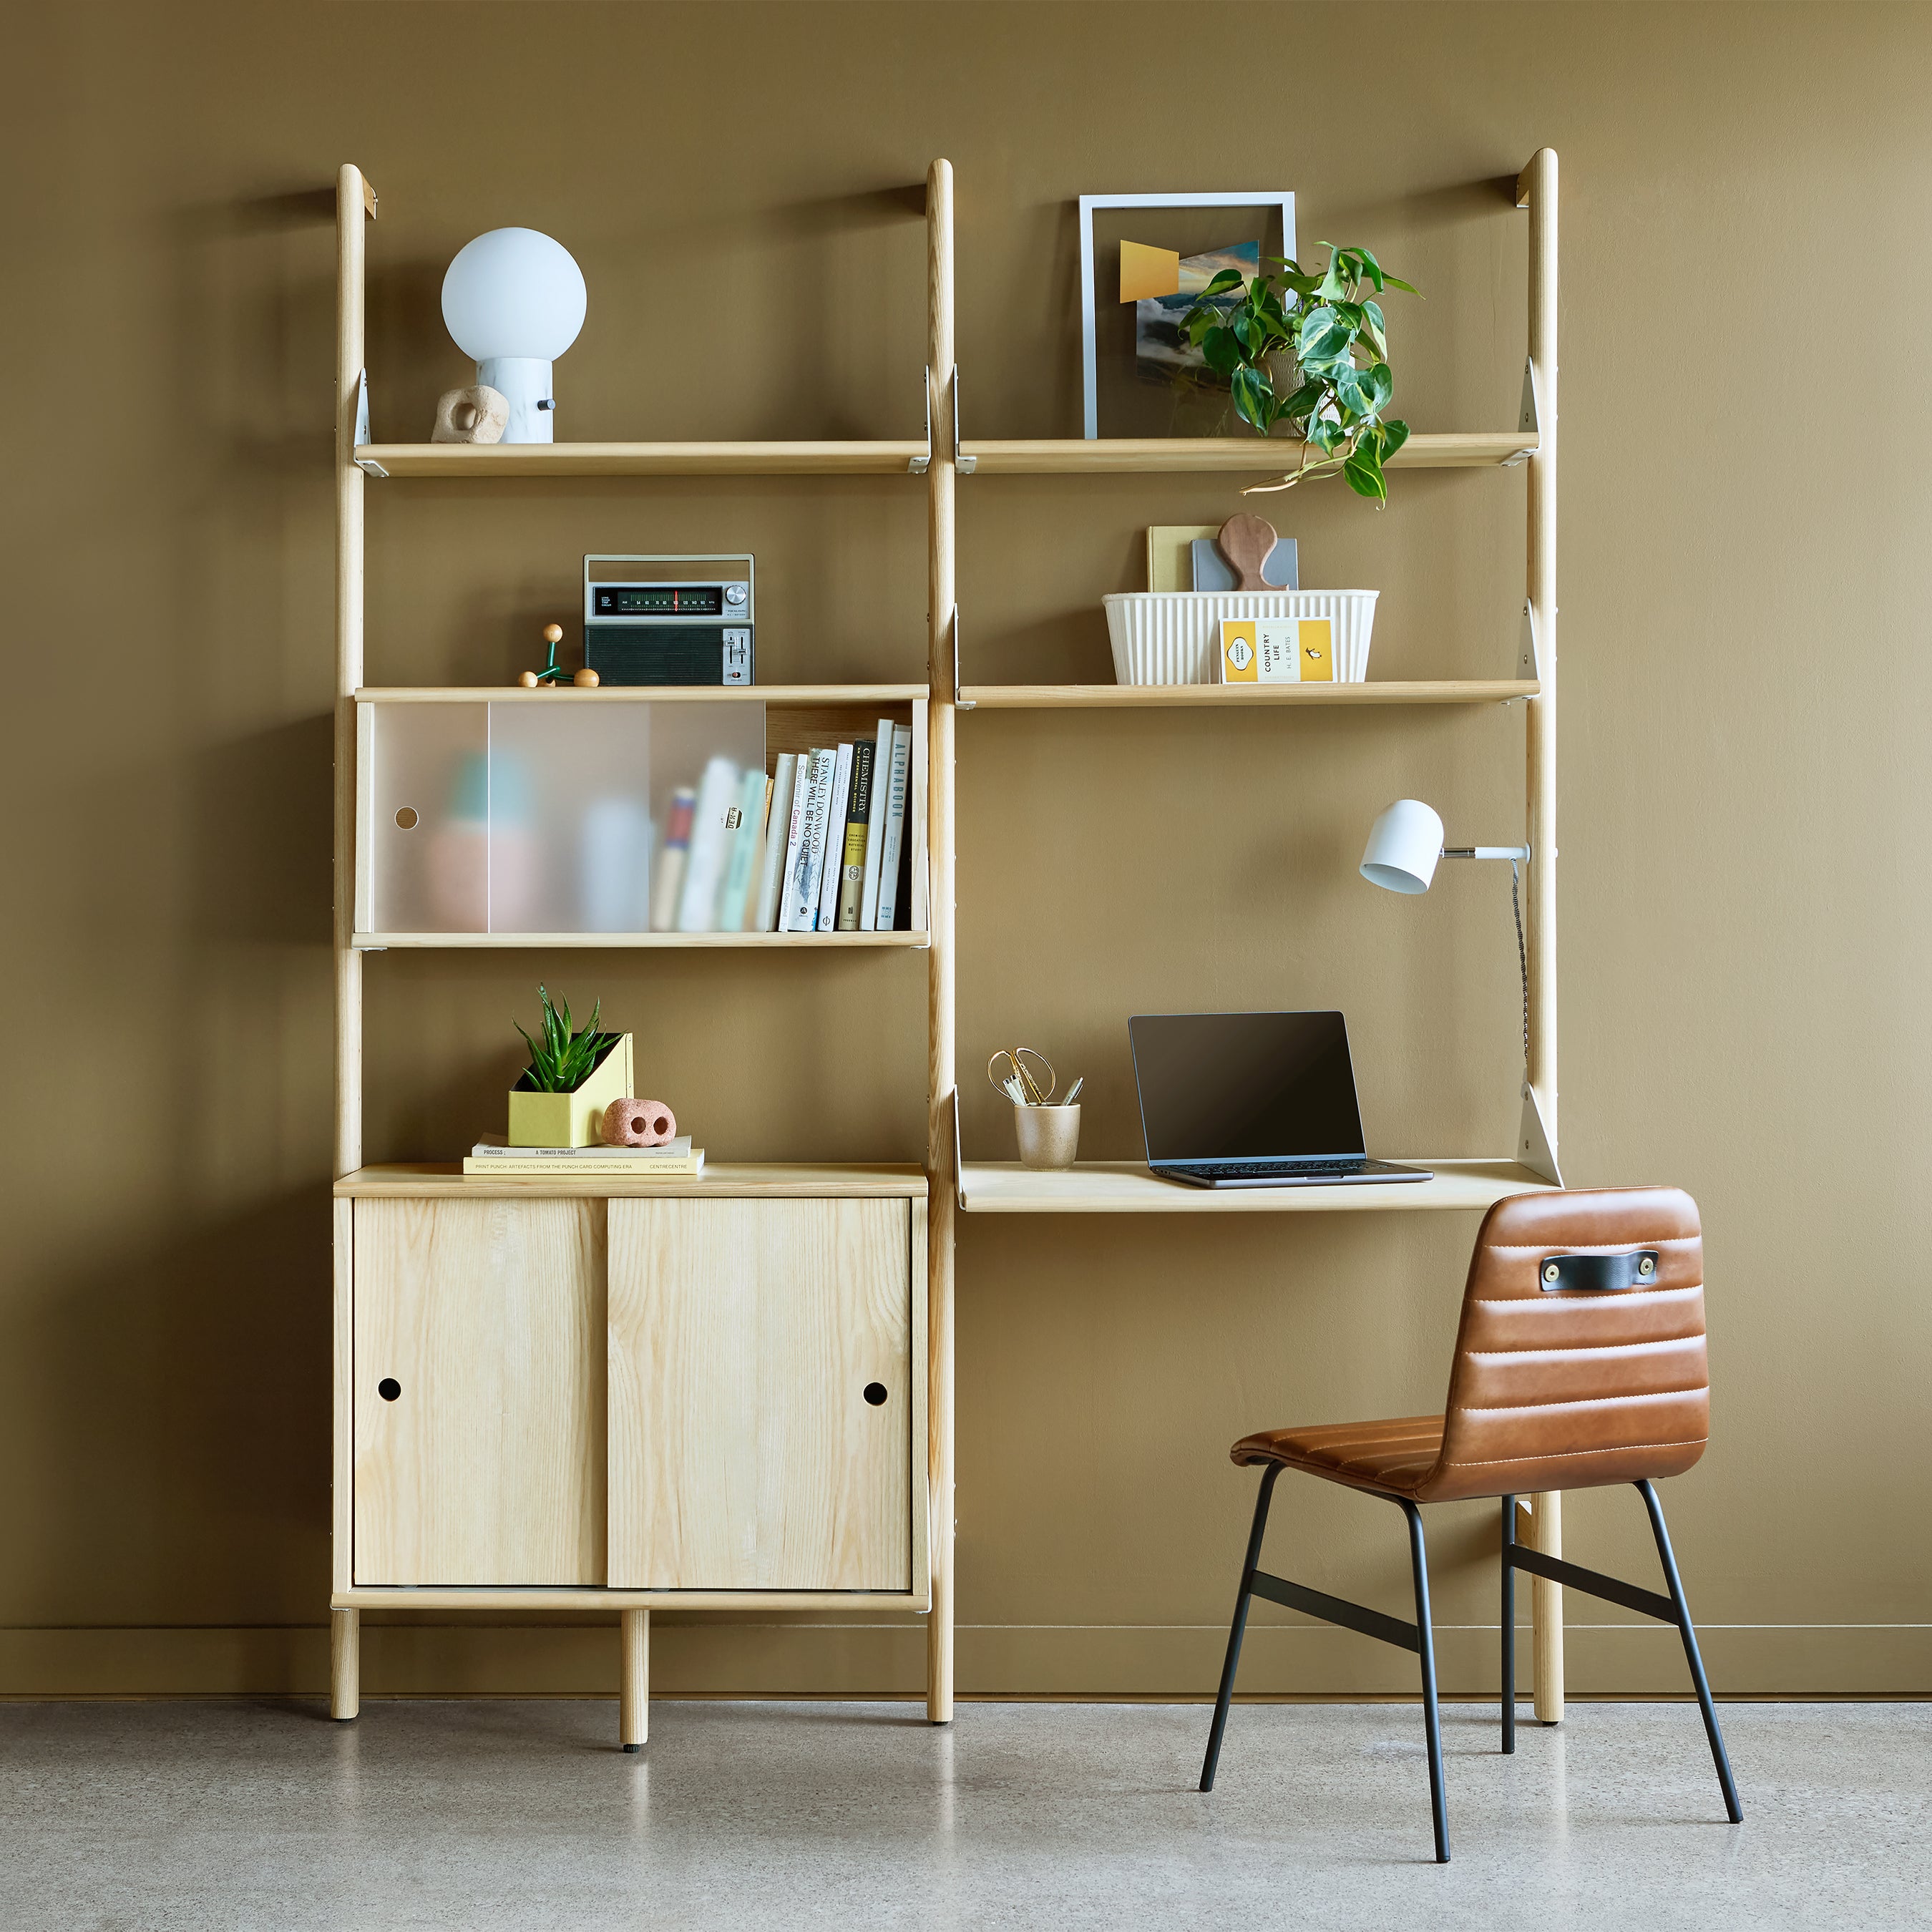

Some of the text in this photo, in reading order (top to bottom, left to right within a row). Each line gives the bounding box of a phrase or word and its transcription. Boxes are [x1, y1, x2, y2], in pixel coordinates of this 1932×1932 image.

[1263, 633, 1272, 673] COUNTRY
[794, 799, 801, 808] of
[795, 765, 805, 799] Souvenir
[811, 757, 830, 854] STANLEY DONWOOD
[859, 748, 871, 814] CHEMISTRY
[892, 743, 906, 817] ALPHABOOK
[791, 809, 800, 839] Canada
[800, 757, 821, 867] THERE WILL BE NO QUIET
